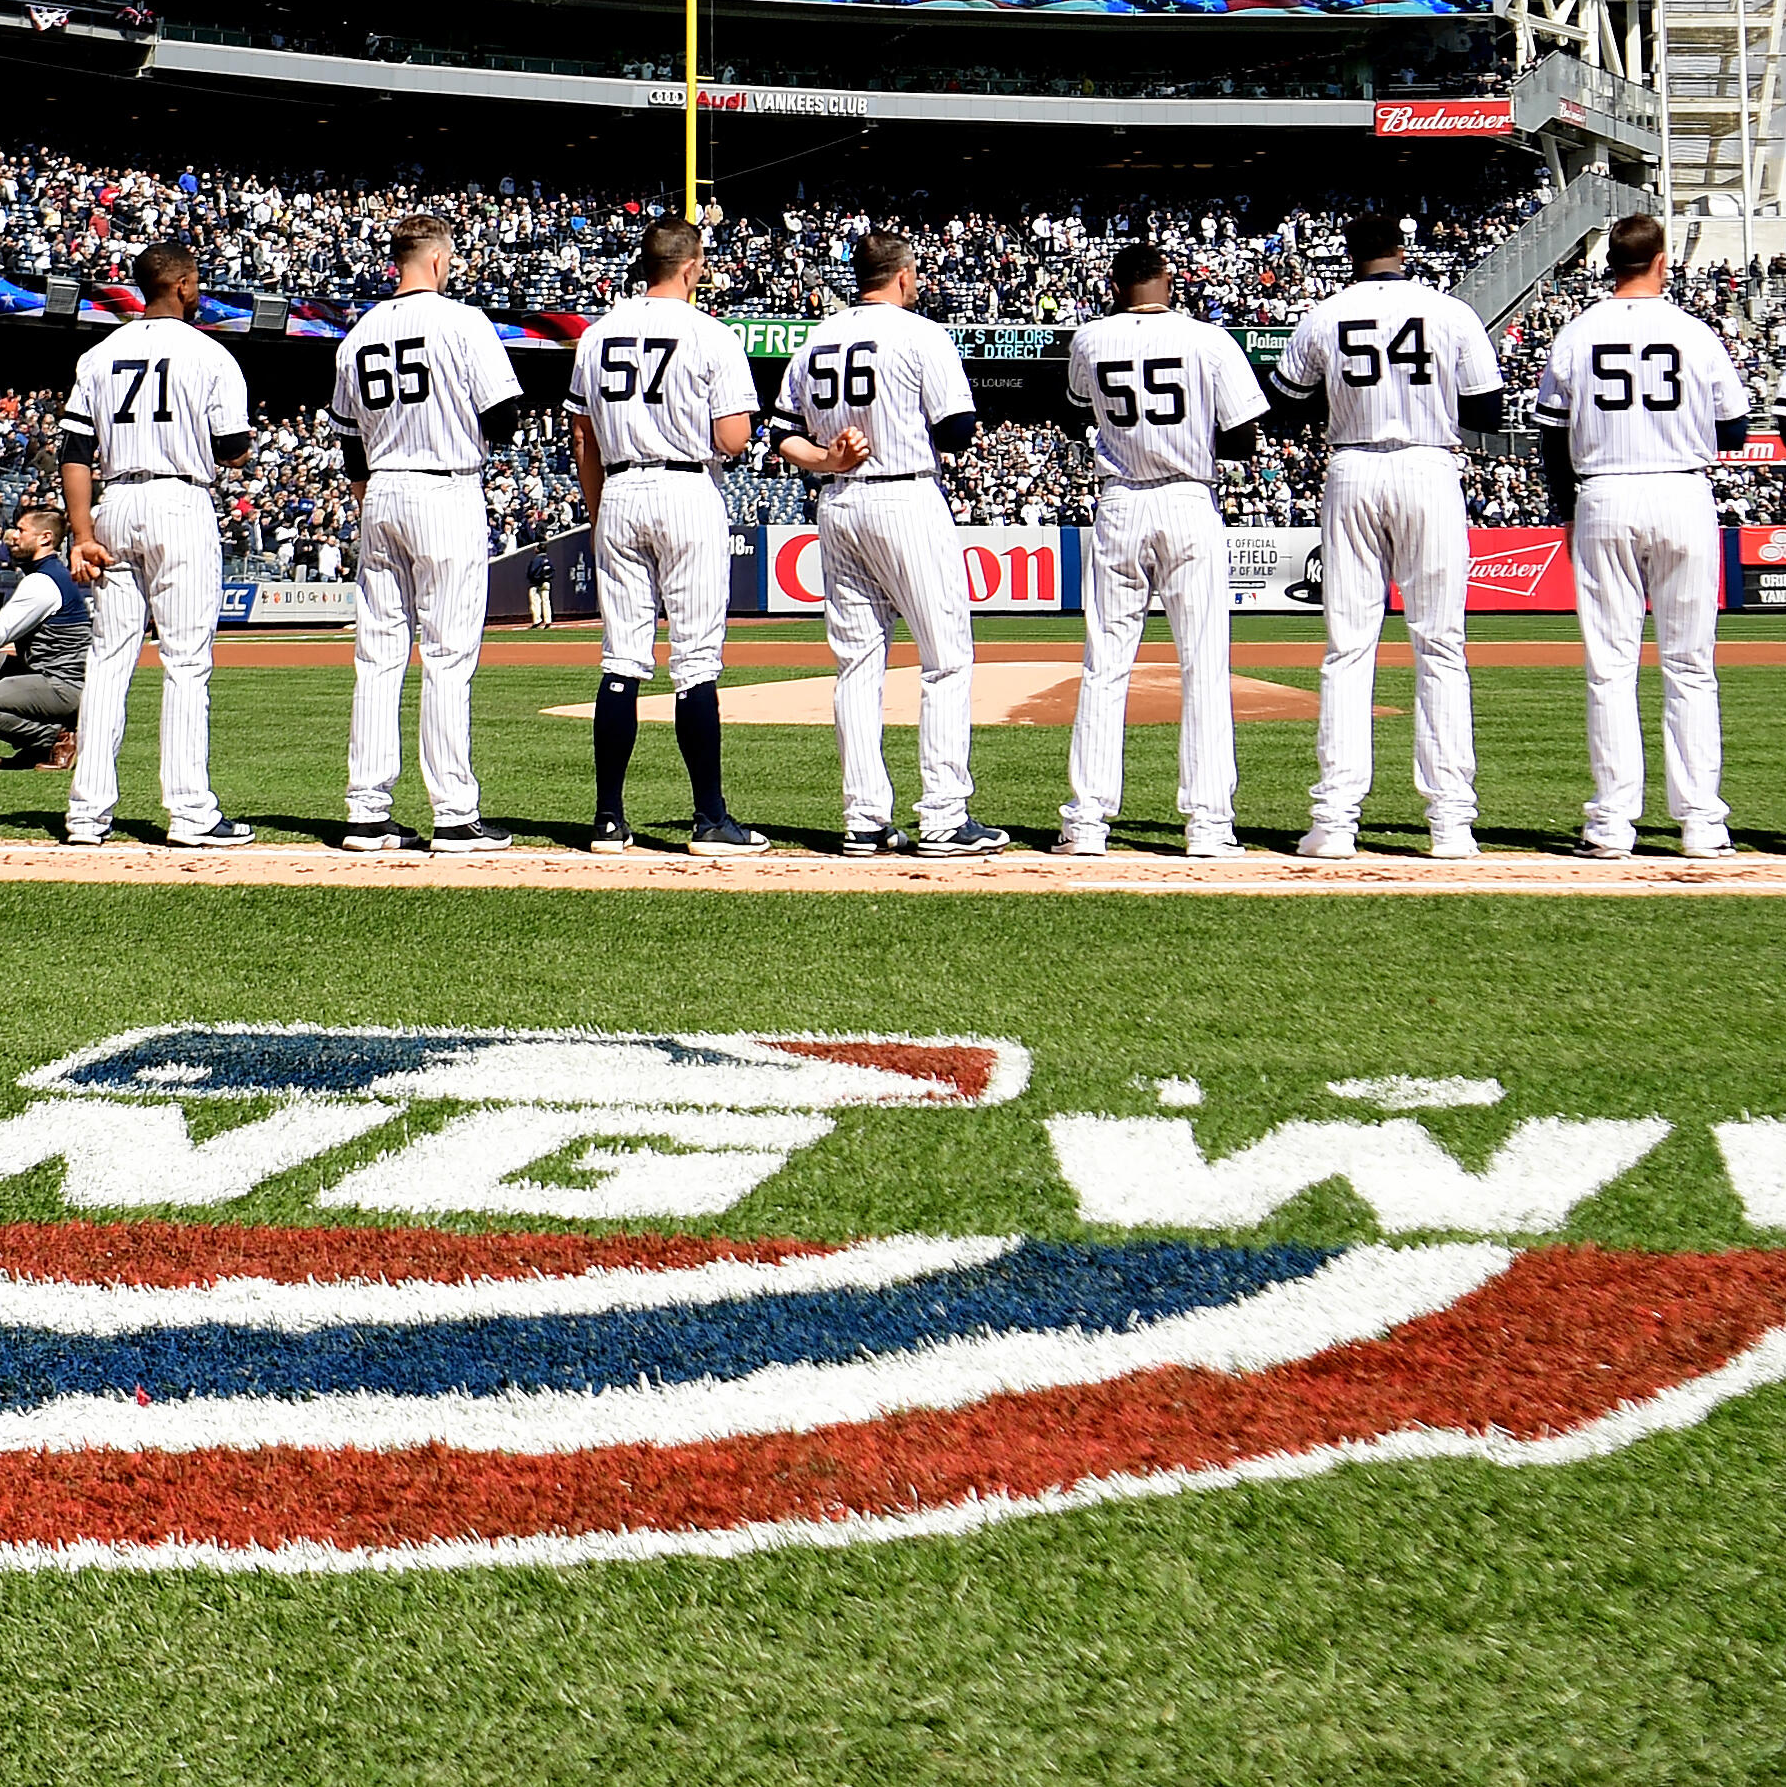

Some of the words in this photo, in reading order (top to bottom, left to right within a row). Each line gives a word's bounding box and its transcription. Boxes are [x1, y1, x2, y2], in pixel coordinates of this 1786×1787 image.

[696, 90, 748, 109] Audi
[754, 92, 825, 112] YANKEES
[827, 96, 869, 114] CLUB
[1377, 106, 1514, 133] Budweiser
[984, 343, 1044, 358] DIRECT
[994, 328, 1061, 345] COLORS.
[1336, 317, 1434, 389] 54
[110, 357, 174, 426] 71
[354, 336, 431, 412] 65
[597, 336, 679, 405] 57
[806, 340, 879, 411] 56
[982, 378, 1024, 388] LOUNGE
[1095, 357, 1189, 429] 55
[1590, 342, 1683, 413] 53
[775, 533, 1055, 603] Con
[1235, 539, 1277, 549] OFFICIAL
[1239, 566, 1251, 576] OF
[1254, 566, 1274, 576] MLB
[222, 589, 249, 610] CC
